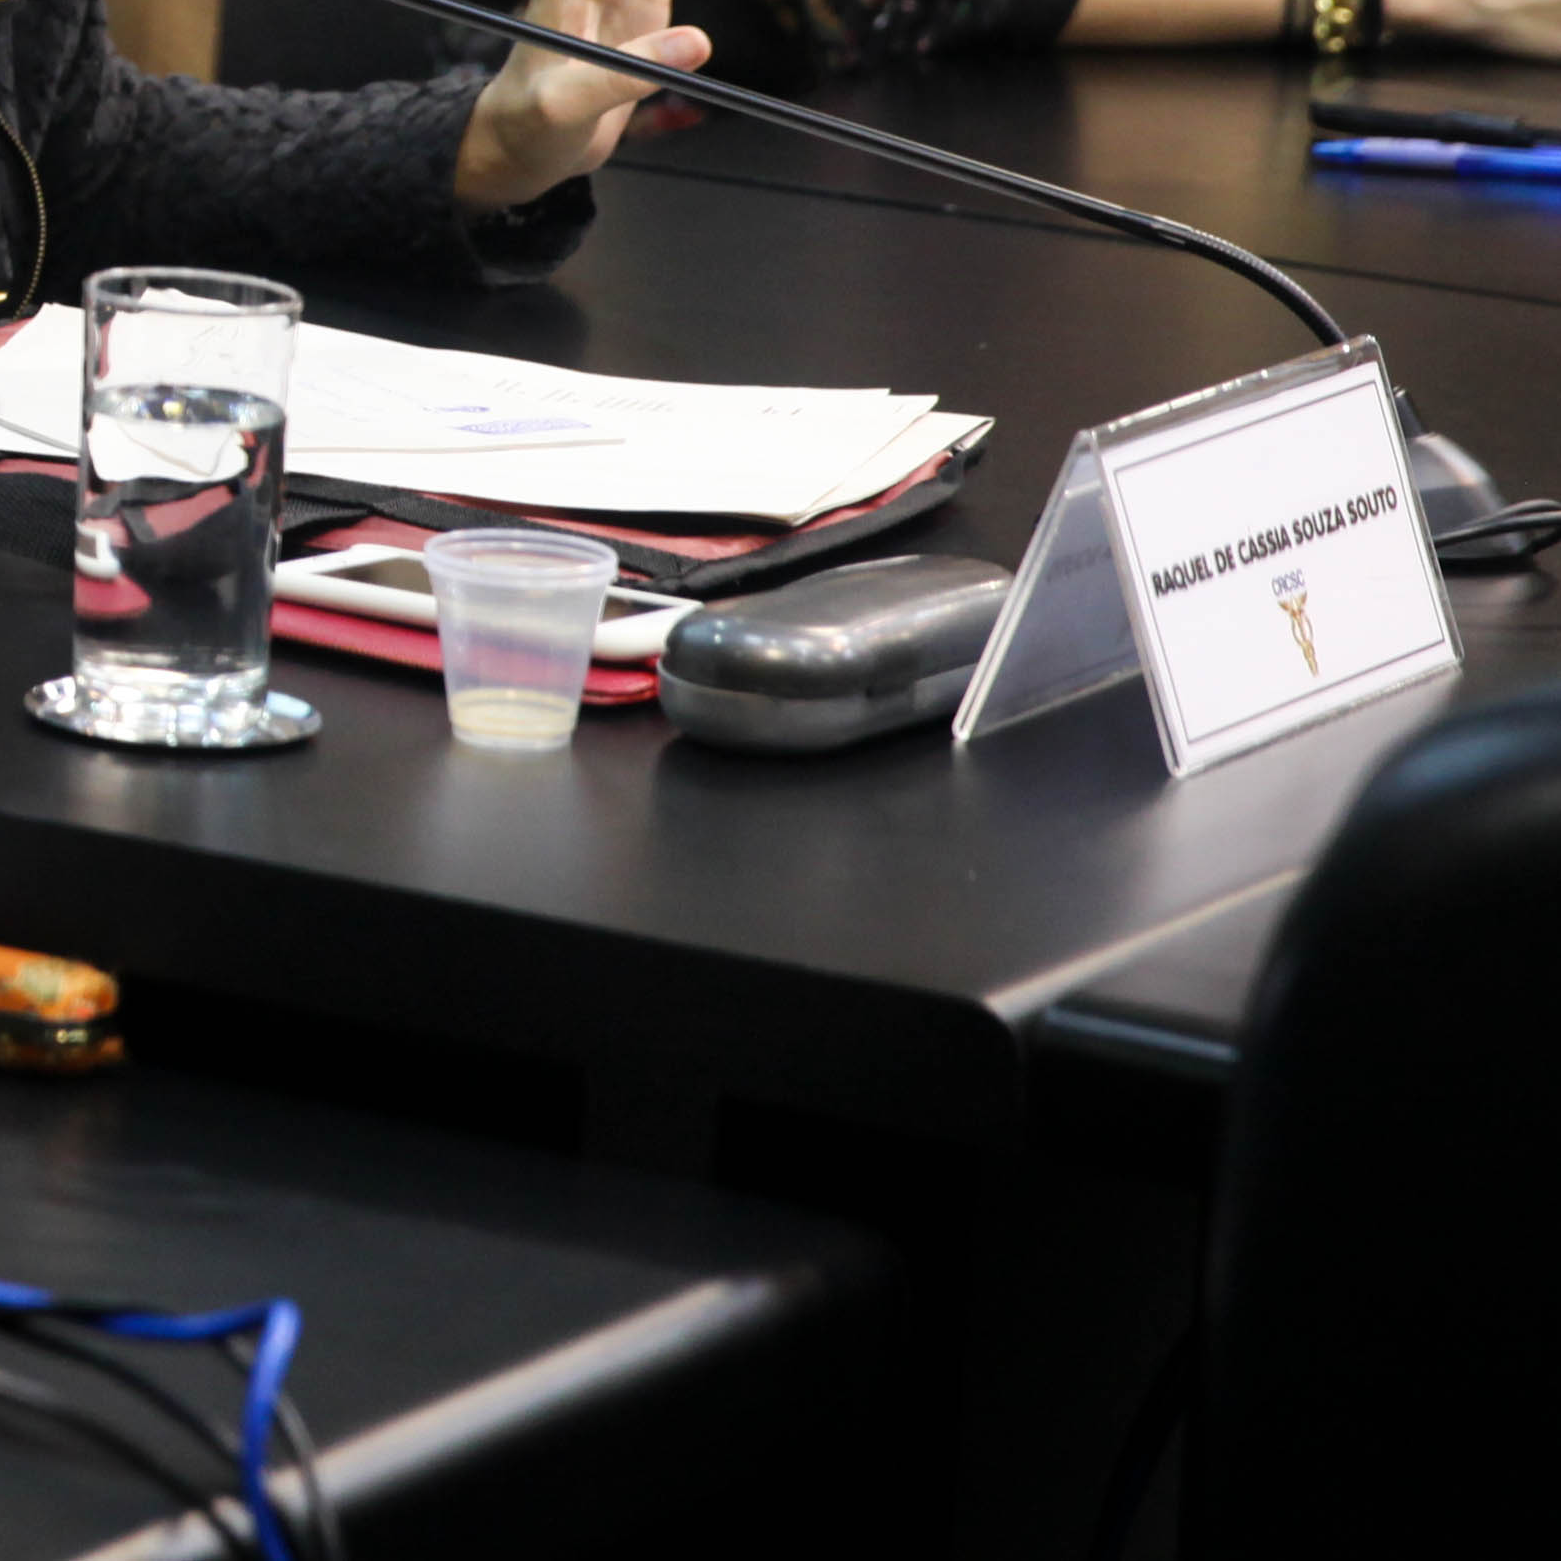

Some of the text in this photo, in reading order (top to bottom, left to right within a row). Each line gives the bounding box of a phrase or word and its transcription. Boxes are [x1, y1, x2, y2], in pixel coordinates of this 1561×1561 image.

[1151, 554, 1213, 598] RAQUEL
[1214, 542, 1236, 575] DE
[1292, 504, 1347, 544] SOUZA
[1347, 485, 1398, 524] SOUTO
